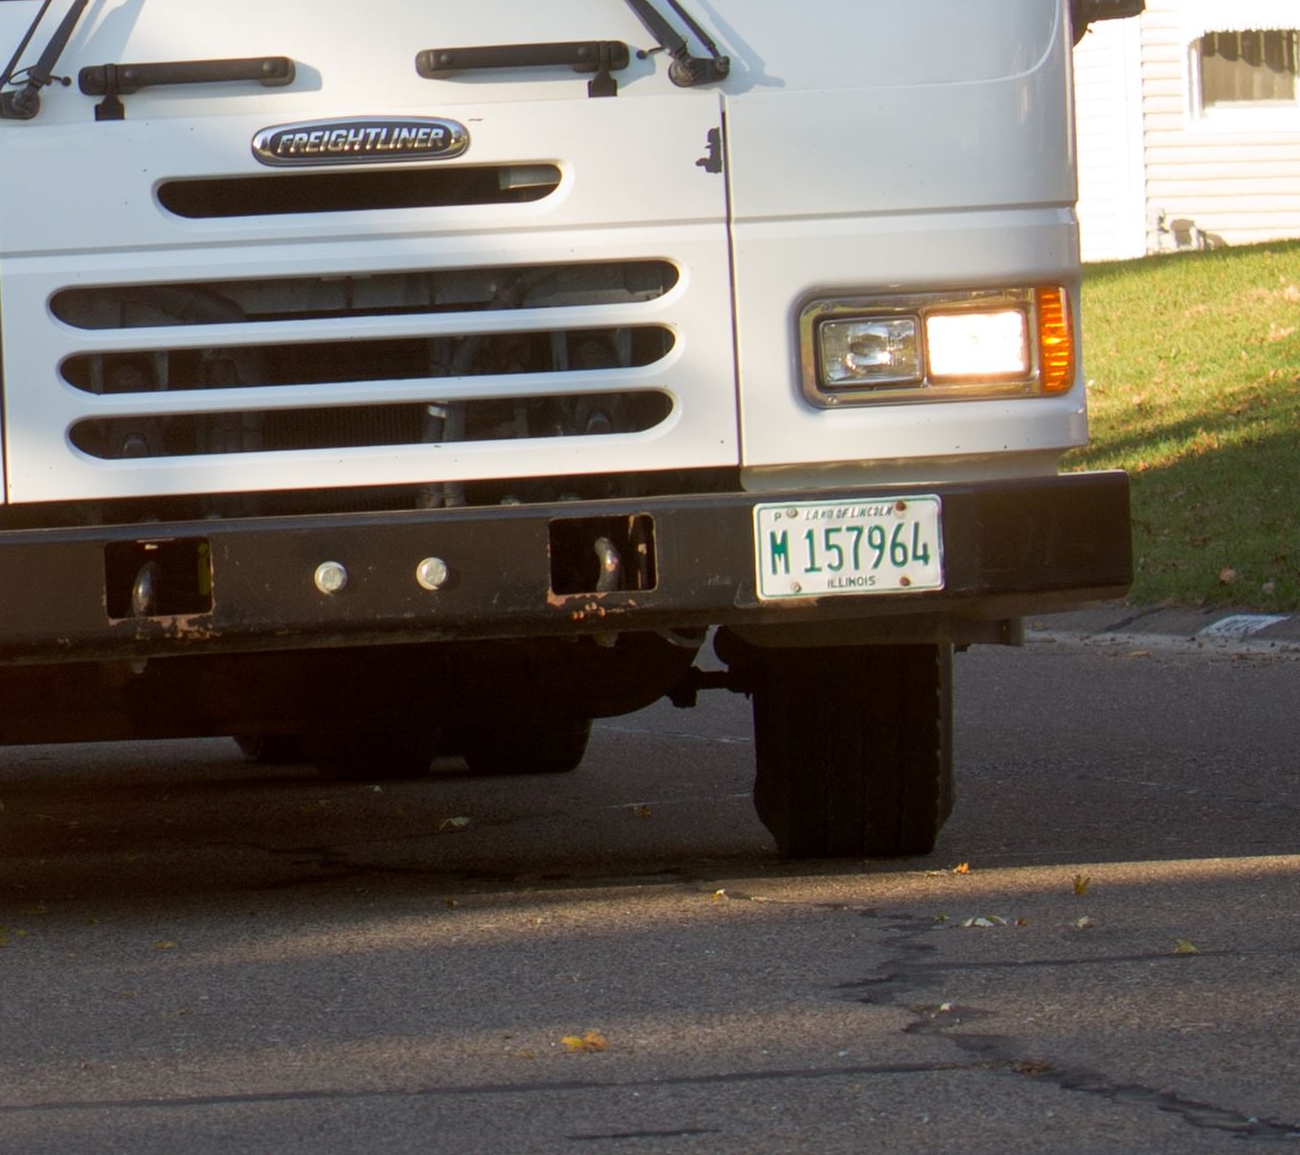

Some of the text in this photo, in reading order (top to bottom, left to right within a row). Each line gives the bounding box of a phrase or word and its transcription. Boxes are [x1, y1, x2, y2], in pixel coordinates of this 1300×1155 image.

[277, 127, 445, 154] FREIGHTLINER
[805, 505, 894, 522] LAND OF LINCOLN
[769, 521, 931, 576] M 157964
[826, 575, 877, 589] ILLINOIS
